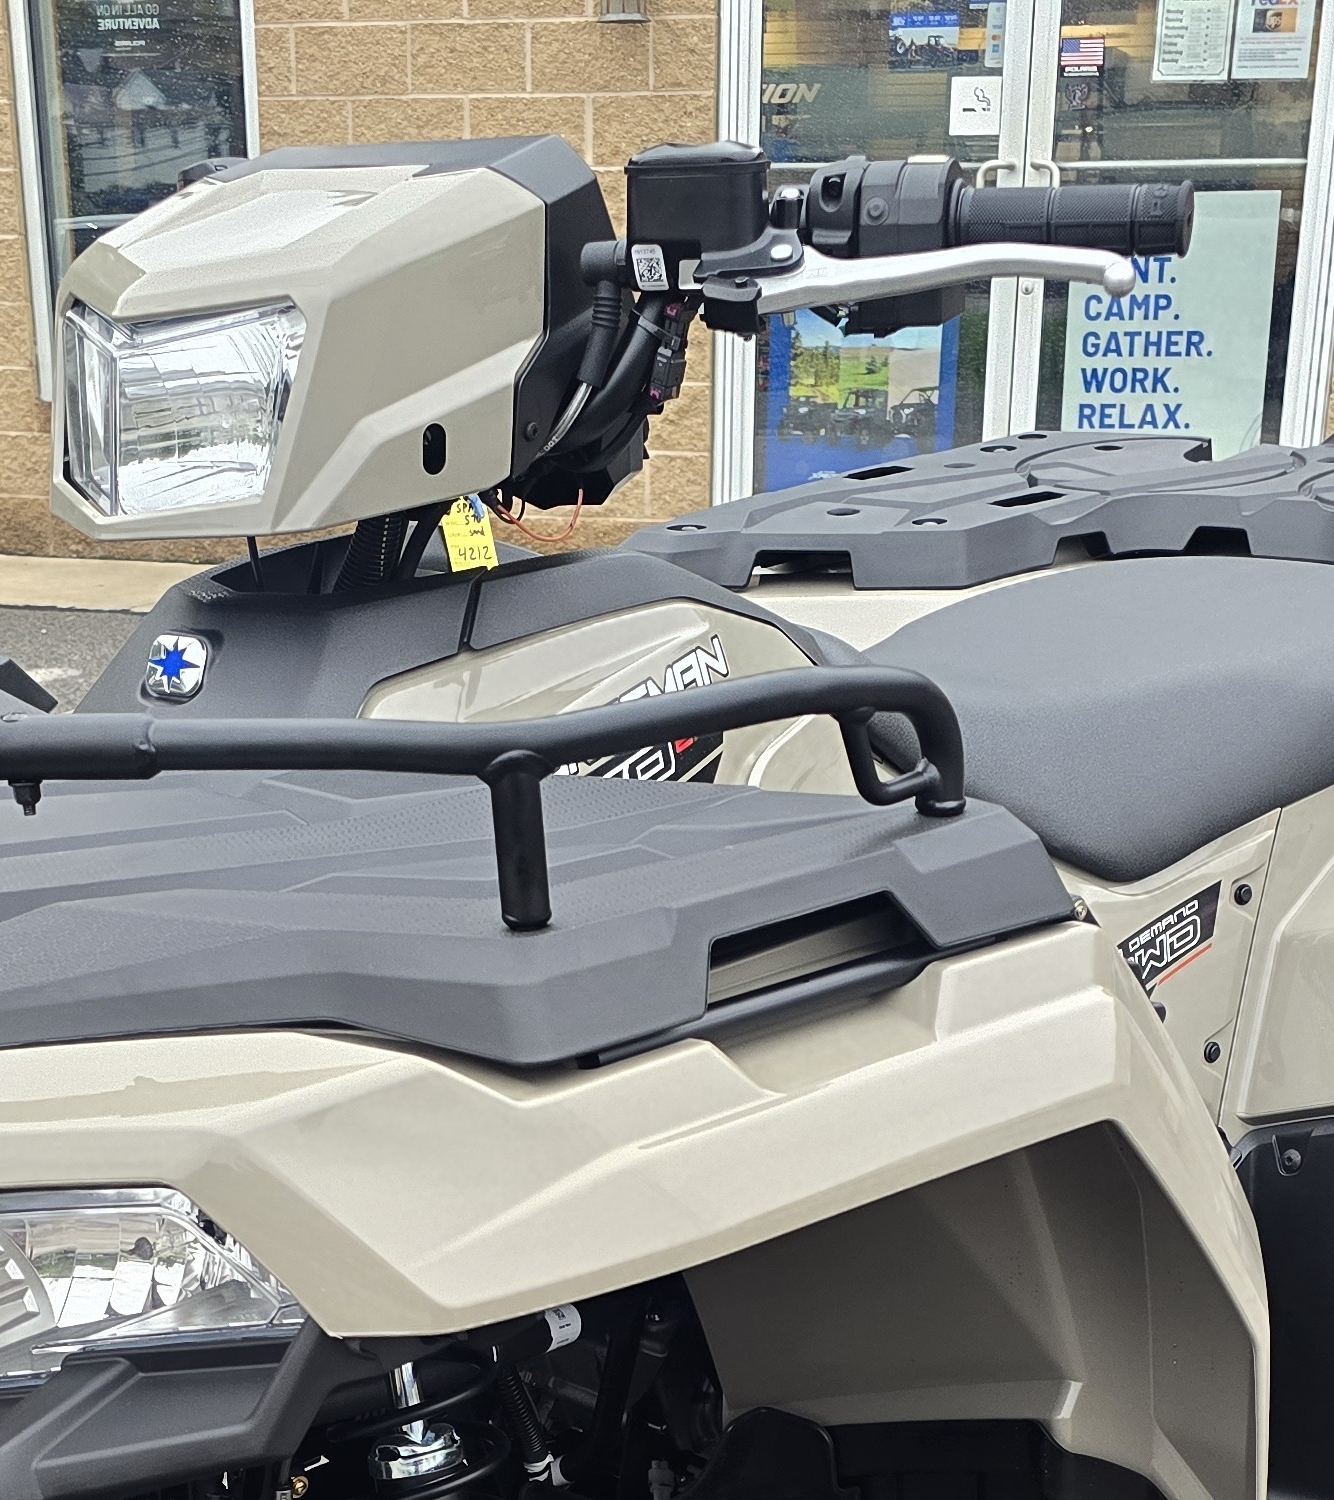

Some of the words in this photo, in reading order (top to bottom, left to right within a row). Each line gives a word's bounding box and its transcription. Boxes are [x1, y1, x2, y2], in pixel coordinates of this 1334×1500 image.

[1084, 294, 1180, 321] CAMP.
[1082, 330, 1213, 357] GATHER.
[1080, 367, 1180, 393] WORK.
[1077, 403, 1190, 430] RELAX.
[458, 545, 492, 561] 4212
[1128, 899, 1199, 953] DEMAND
